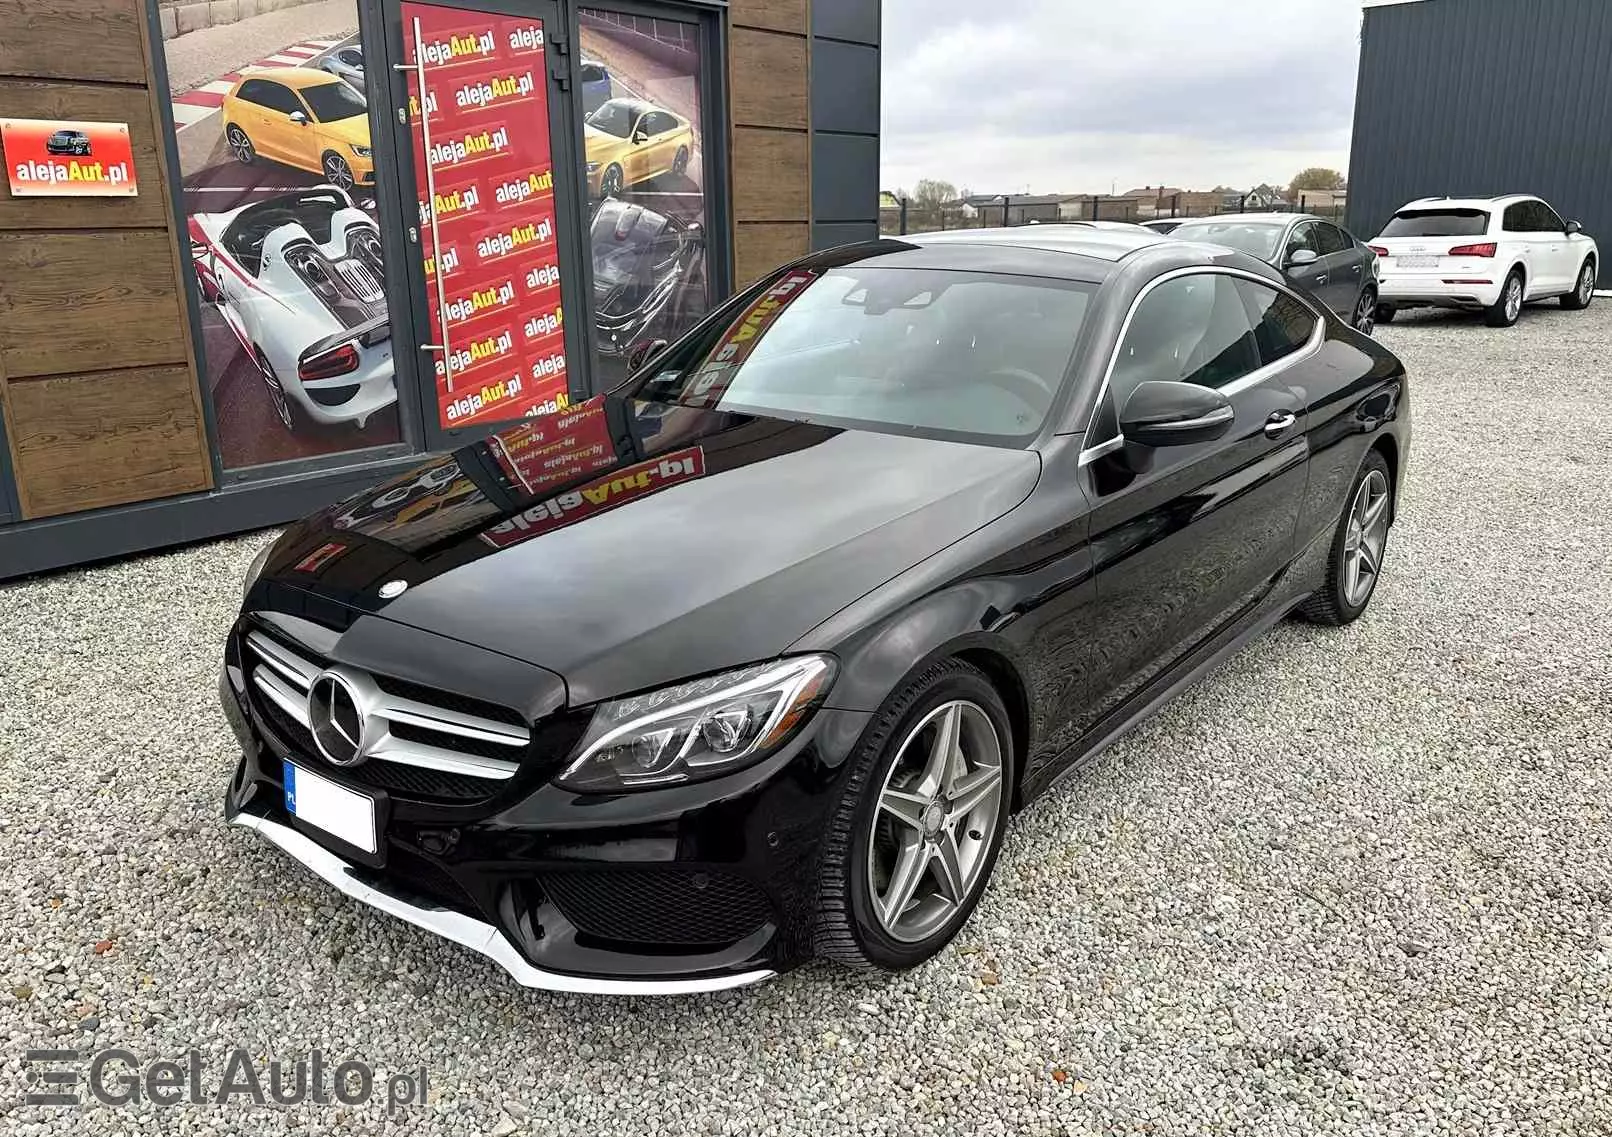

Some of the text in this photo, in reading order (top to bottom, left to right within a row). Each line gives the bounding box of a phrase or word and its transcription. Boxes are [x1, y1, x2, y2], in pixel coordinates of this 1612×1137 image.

[455, 71, 535, 107] alejaAut.pl
[430, 127, 509, 165] alejaAut.pl
[16, 159, 129, 186] alejaAut.pl
[477, 217, 553, 258] alejaAut.pl
[525, 263, 560, 289] aleja
[435, 330, 513, 375] aejaAut.pl
[532, 353, 566, 379] aleja
[446, 374, 522, 420] alejaAut.pl
